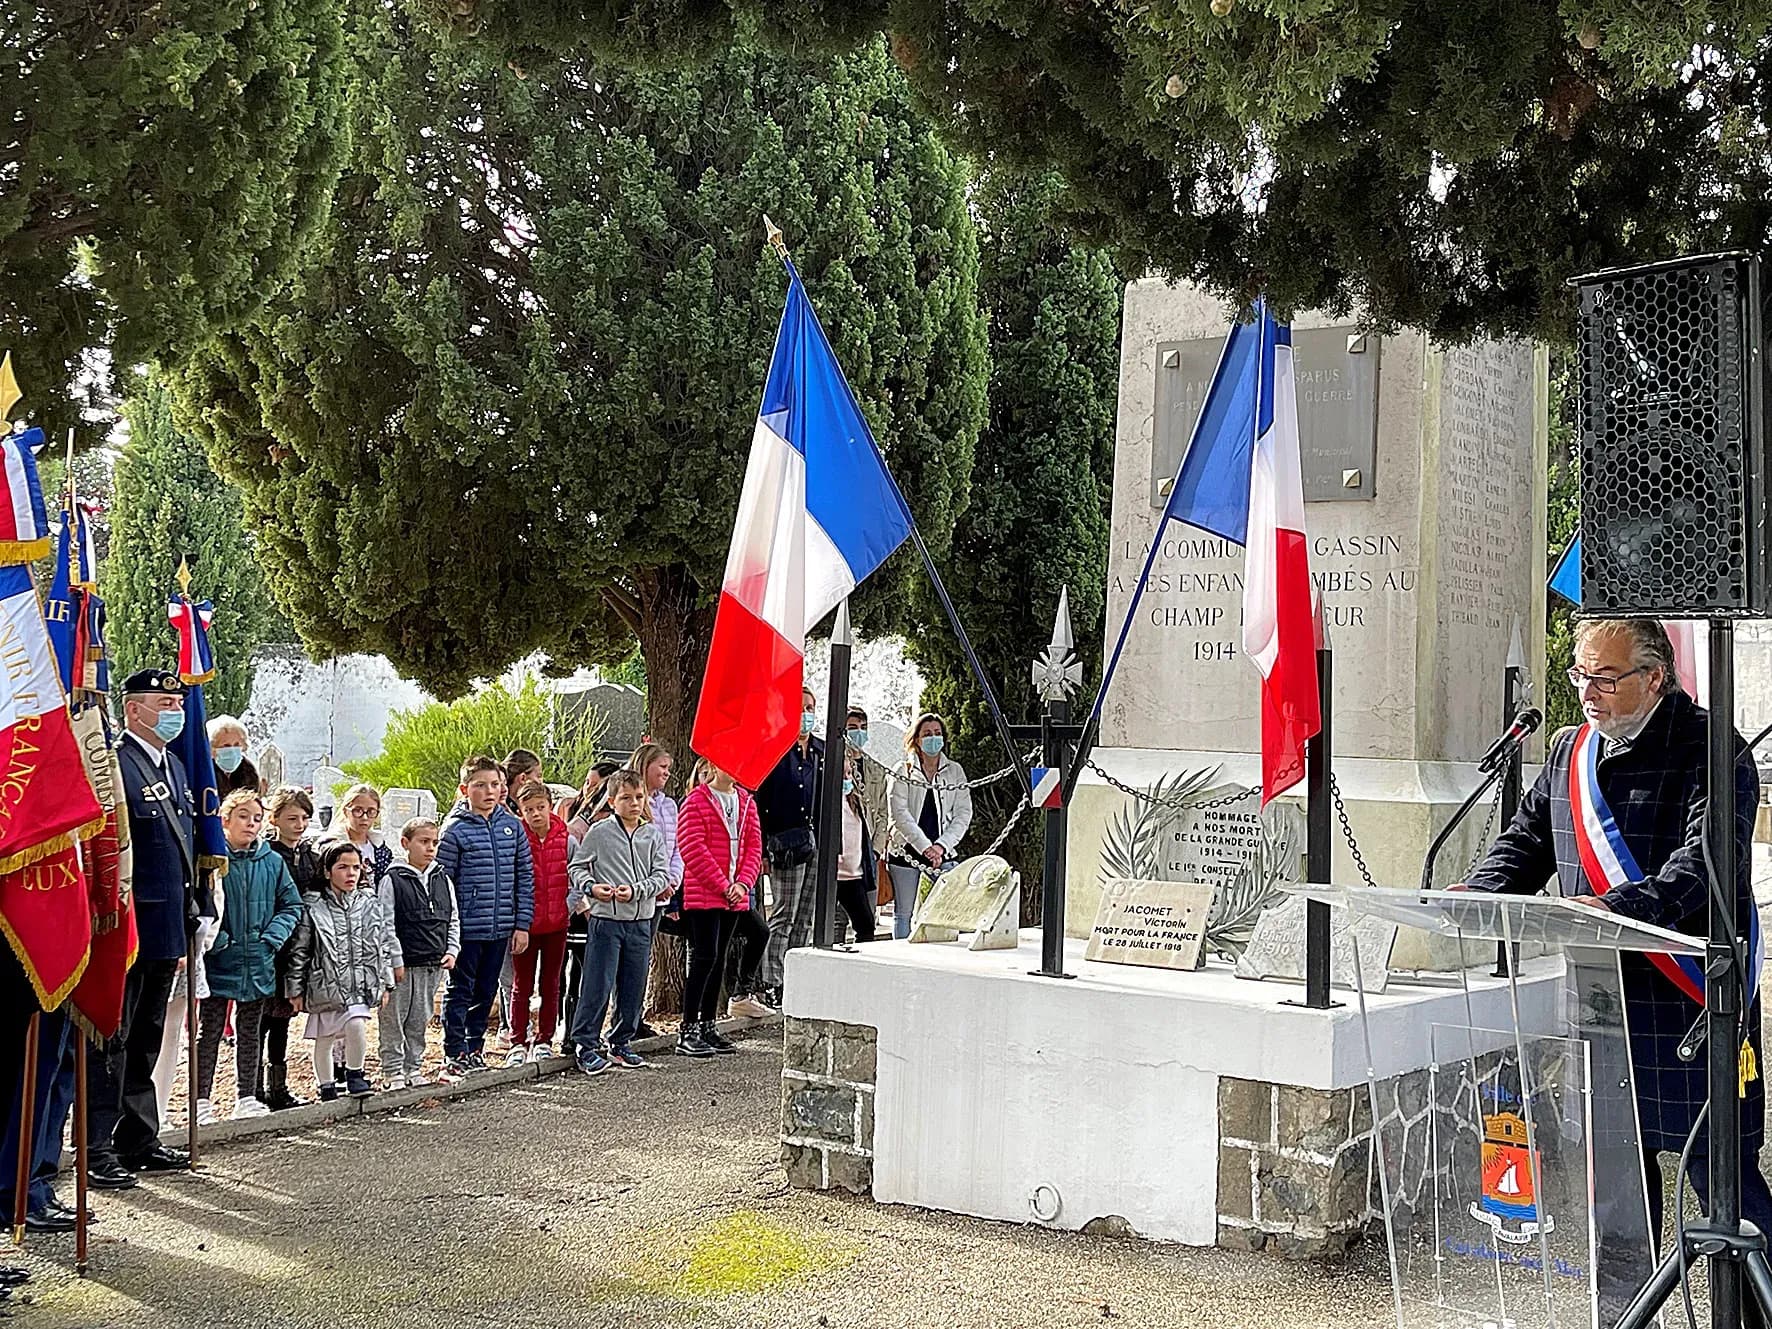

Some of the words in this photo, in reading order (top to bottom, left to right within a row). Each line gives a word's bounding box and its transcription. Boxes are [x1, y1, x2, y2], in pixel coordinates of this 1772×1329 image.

[1304, 389, 1353, 402] GUERRE
[1125, 541, 1150, 560] LA
[1164, 539, 1245, 559] COMMU
[1314, 536, 1402, 556] GASSIN
[1110, 576, 1124, 592] A
[1179, 573, 1244, 592] ENFAN
[1311, 565, 1372, 592] MBÉS
[1381, 571, 1416, 591] AU
[1151, 607, 1223, 626] CHAMP
[1194, 641, 1236, 660] 1914
[1205, 811, 1257, 823] HOMMAGE
[1229, 825, 1261, 836] MORT
[1175, 833, 1187, 841] DE
[1190, 834, 1201, 843] LA
[1206, 836, 1243, 846] GRANDE
[1200, 847, 1222, 856] 1914
[1169, 862, 1180, 871] LE
[1124, 905, 1173, 916] JACOMET
[1144, 917, 1187, 928] VICTORIN
[1095, 926, 1119, 935] MORT
[1121, 928, 1146, 937] POUR
[1147, 930, 1159, 938] LA
[1161, 931, 1198, 941] FRANCE
[1103, 938, 1114, 946] LE
[1128, 940, 1162, 950] JUILLET
